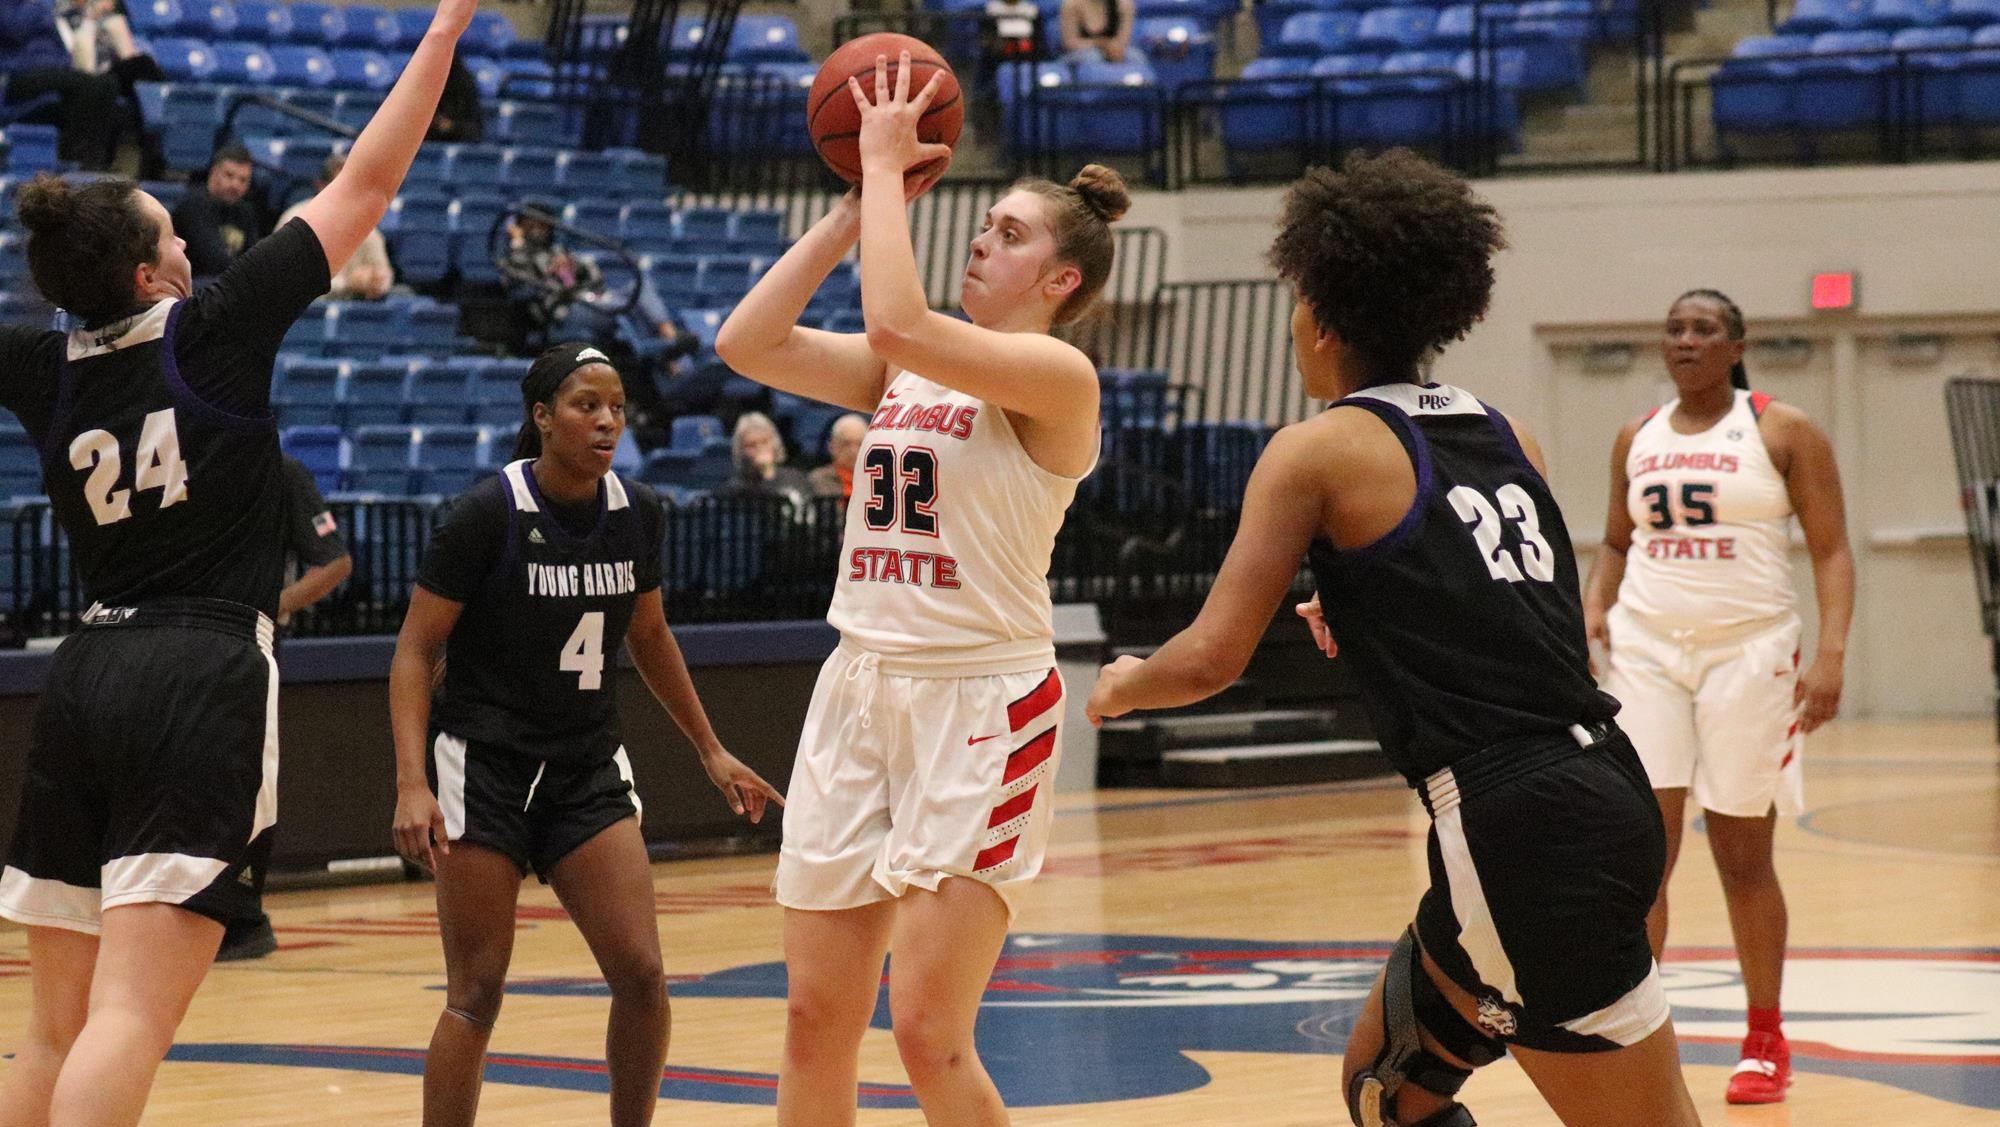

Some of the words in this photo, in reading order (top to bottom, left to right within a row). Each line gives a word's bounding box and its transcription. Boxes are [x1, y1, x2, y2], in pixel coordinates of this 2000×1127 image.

[68, 407, 188, 526] 24
[864, 443, 939, 539] 32
[1446, 483, 1554, 583] 23
[1642, 483, 1715, 530] 35
[527, 562, 579, 597] YOUNG
[583, 560, 636, 596] HARRIS
[849, 547, 962, 589] STATE
[1647, 537, 1737, 559] STATE
[559, 611, 605, 690] 4
